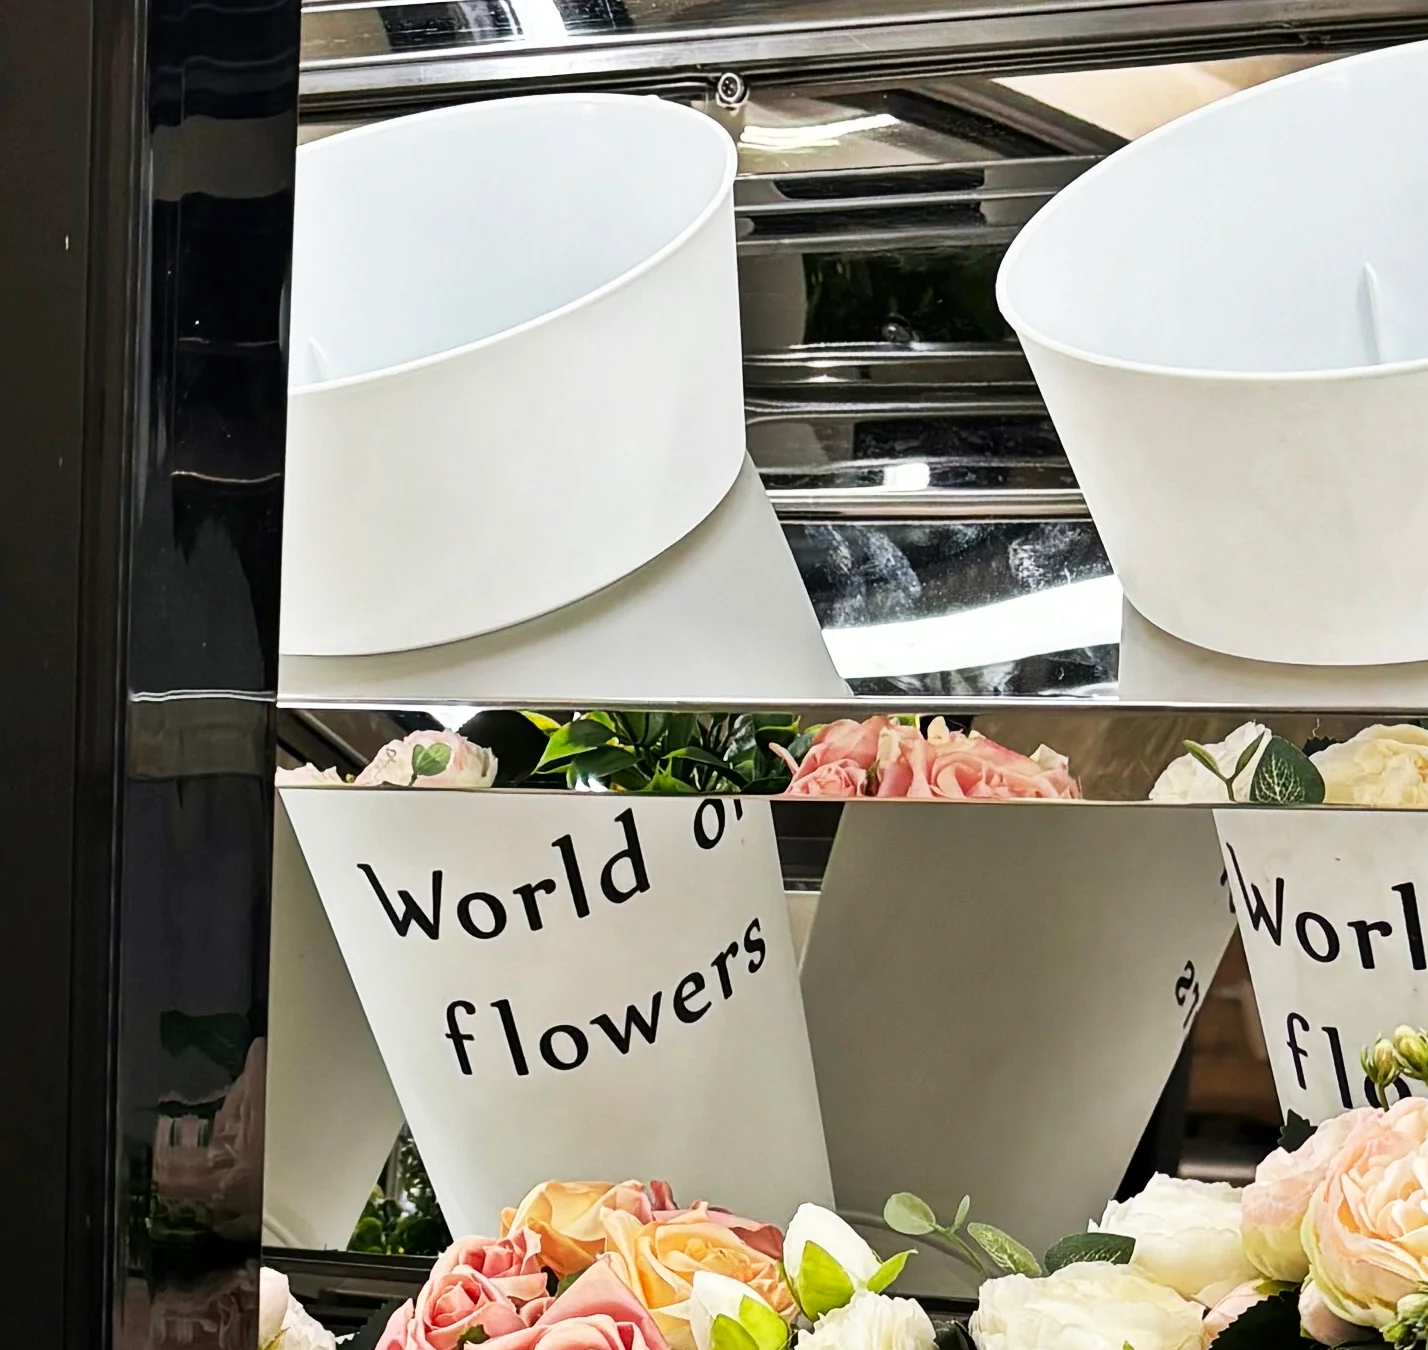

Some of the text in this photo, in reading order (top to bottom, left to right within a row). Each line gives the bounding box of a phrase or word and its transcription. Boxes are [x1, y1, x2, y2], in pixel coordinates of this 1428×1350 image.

[356, 799, 743, 940] World o
[445, 917, 767, 1076] flowers
